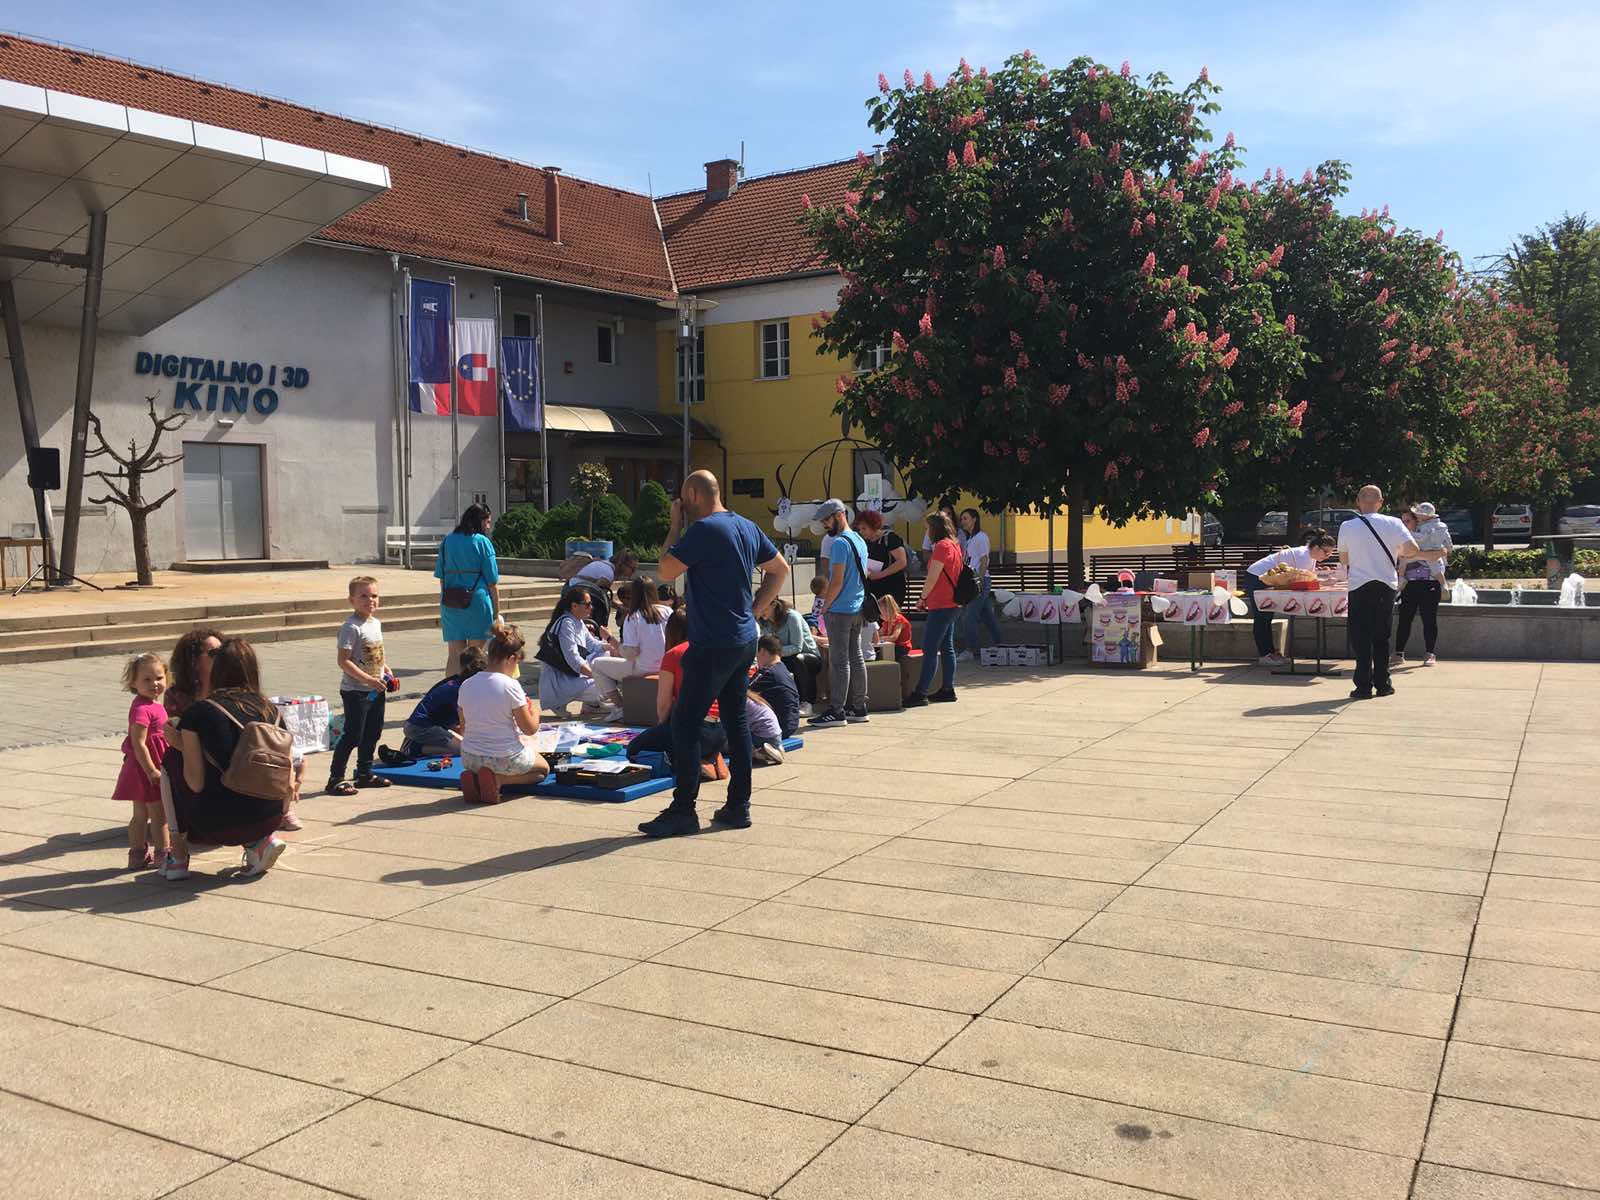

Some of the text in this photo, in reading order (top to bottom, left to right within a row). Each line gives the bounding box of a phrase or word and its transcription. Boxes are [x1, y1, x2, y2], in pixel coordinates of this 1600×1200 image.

[135, 351, 310, 389] DIGITALNO I 3D
[174, 382, 279, 415] KINO
